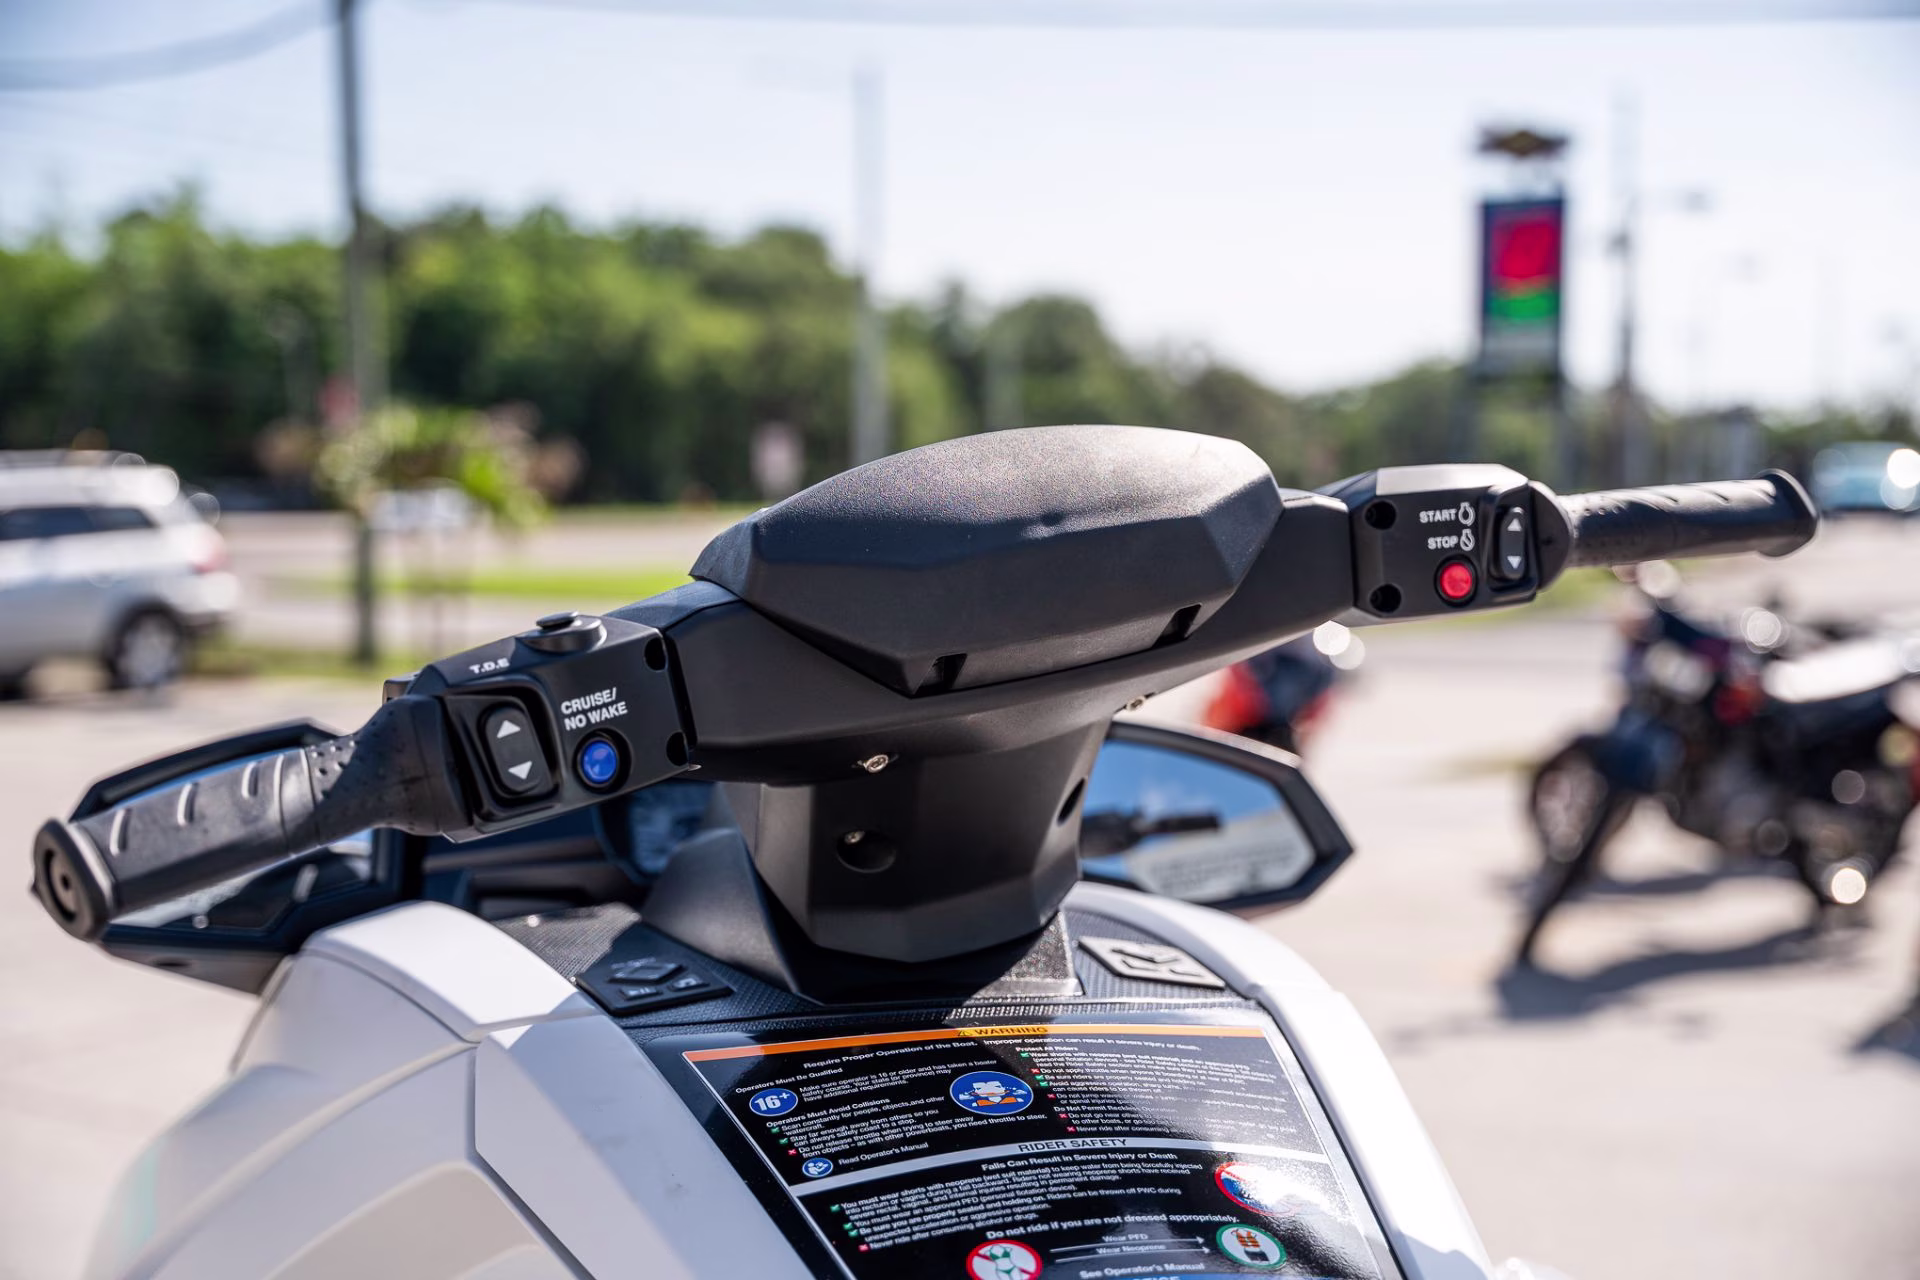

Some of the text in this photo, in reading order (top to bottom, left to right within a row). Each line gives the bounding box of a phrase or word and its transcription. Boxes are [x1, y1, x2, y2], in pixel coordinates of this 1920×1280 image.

[1420, 508, 1457, 524] START
[1428, 536, 1458, 550] STOP
[469, 658, 510, 675] T.D.E
[561, 687, 617, 715] CRUISE/
[564, 700, 628, 732] NO WAKE
[974, 1027, 1048, 1035] WARNING
[804, 1058, 841, 1070] Require
[842, 1053, 874, 1062] Proper
[876, 1047, 923, 1058] Operation
[735, 1081, 775, 1094] Operators
[776, 1076, 796, 1085] Must
[809, 1068, 843, 1080] Qualified
[754, 1092, 790, 1110] 16+
[766, 1099, 890, 1129] Operators Must Avoid Collisions
[782, 1123, 801, 1132] Scan
[802, 1115, 840, 1127] constantly
[854, 1108, 882, 1118] people,
[790, 1135, 807, 1143] Stay
[820, 1126, 848, 1136] enough
[850, 1123, 869, 1131] away
[889, 1114, 913, 1124] others
[925, 1110, 940, 1118] you
[803, 1151, 820, 1159] from
[822, 1144, 849, 1155] objects
[868, 1136, 883, 1144] with
[968, 1119, 987, 1128] need
[989, 1116, 1016, 1124] throttle
[809, 1134, 836, 1145] always
[837, 1129, 858, 1138] safely
[859, 1124, 880, 1134] coast
[812, 1143, 824, 1151] not
[825, 1138, 852, 1148] release
[854, 1133, 880, 1142] throttle
[881, 1128, 901, 1137] when
[902, 1124, 923, 1132] trying
[839, 1143, 929, 1166] Read Operator's Manual
[1018, 1139, 1127, 1153] RIDER SAFETY
[982, 1162, 1006, 1172] Falls
[1007, 1160, 1028, 1168] Can
[1029, 1156, 1062, 1165] Result
[1108, 1153, 1136, 1161] Injury
[869, 1240, 893, 1250] Never
[894, 1236, 911, 1244] ride
[912, 1232, 930, 1241] after
[931, 1224, 974, 1236] consuming
[975, 1218, 1003, 1228] alcohol
[986, 1215, 1240, 1239] Do not ride if you are not dressed appropriately.
[1080, 1263, 1206, 1279] See Operator's Manual
